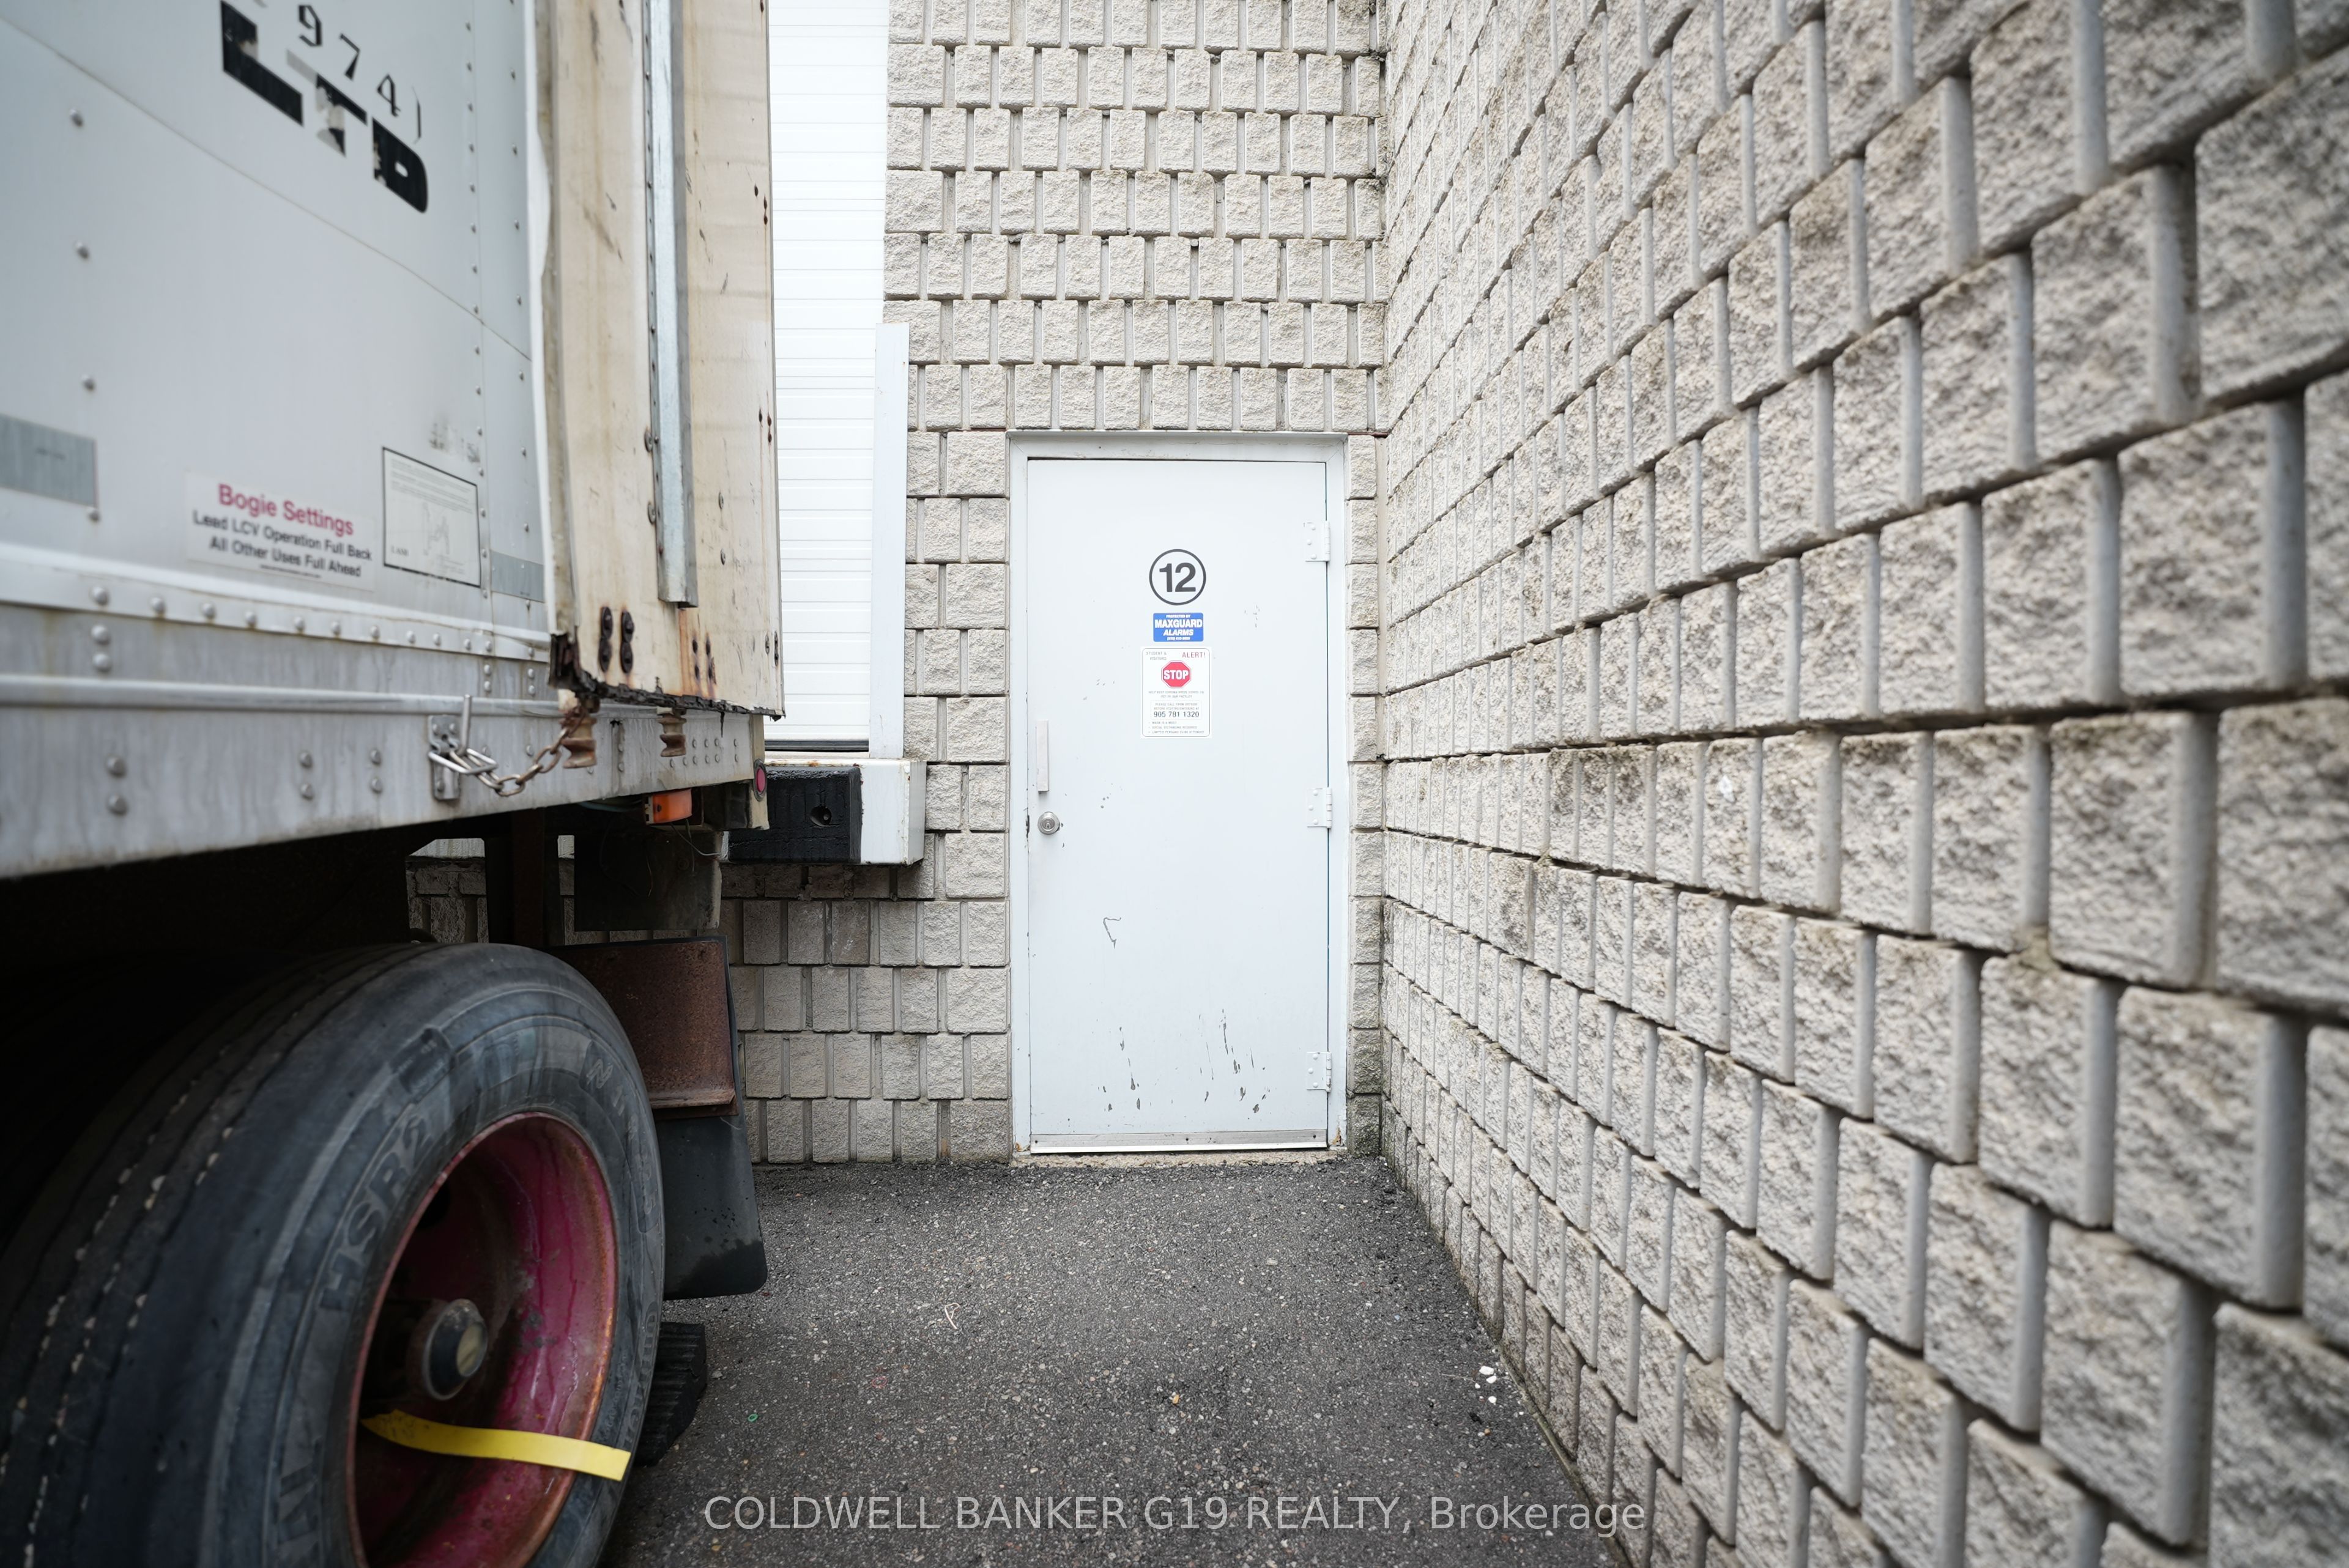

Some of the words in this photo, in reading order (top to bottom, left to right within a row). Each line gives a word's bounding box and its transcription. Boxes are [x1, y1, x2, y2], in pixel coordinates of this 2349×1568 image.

[218, 483, 277, 518] Bogie
[283, 500, 354, 538] Settings
[193, 509, 228, 531] Lead
[232, 517, 260, 536] LCV
[263, 525, 322, 550] Operation
[325, 539, 345, 555] Full
[347, 543, 372, 561] Back
[210, 535, 229, 552] All
[232, 539, 267, 559] Other
[272, 548, 302, 566] Uses
[305, 553, 325, 570] Full
[328, 560, 362, 577] Ahead
[1159, 562, 1196, 593] 12
[1154, 619, 1203, 628] MAXGUARD
[1163, 669, 1189, 680] STOP
